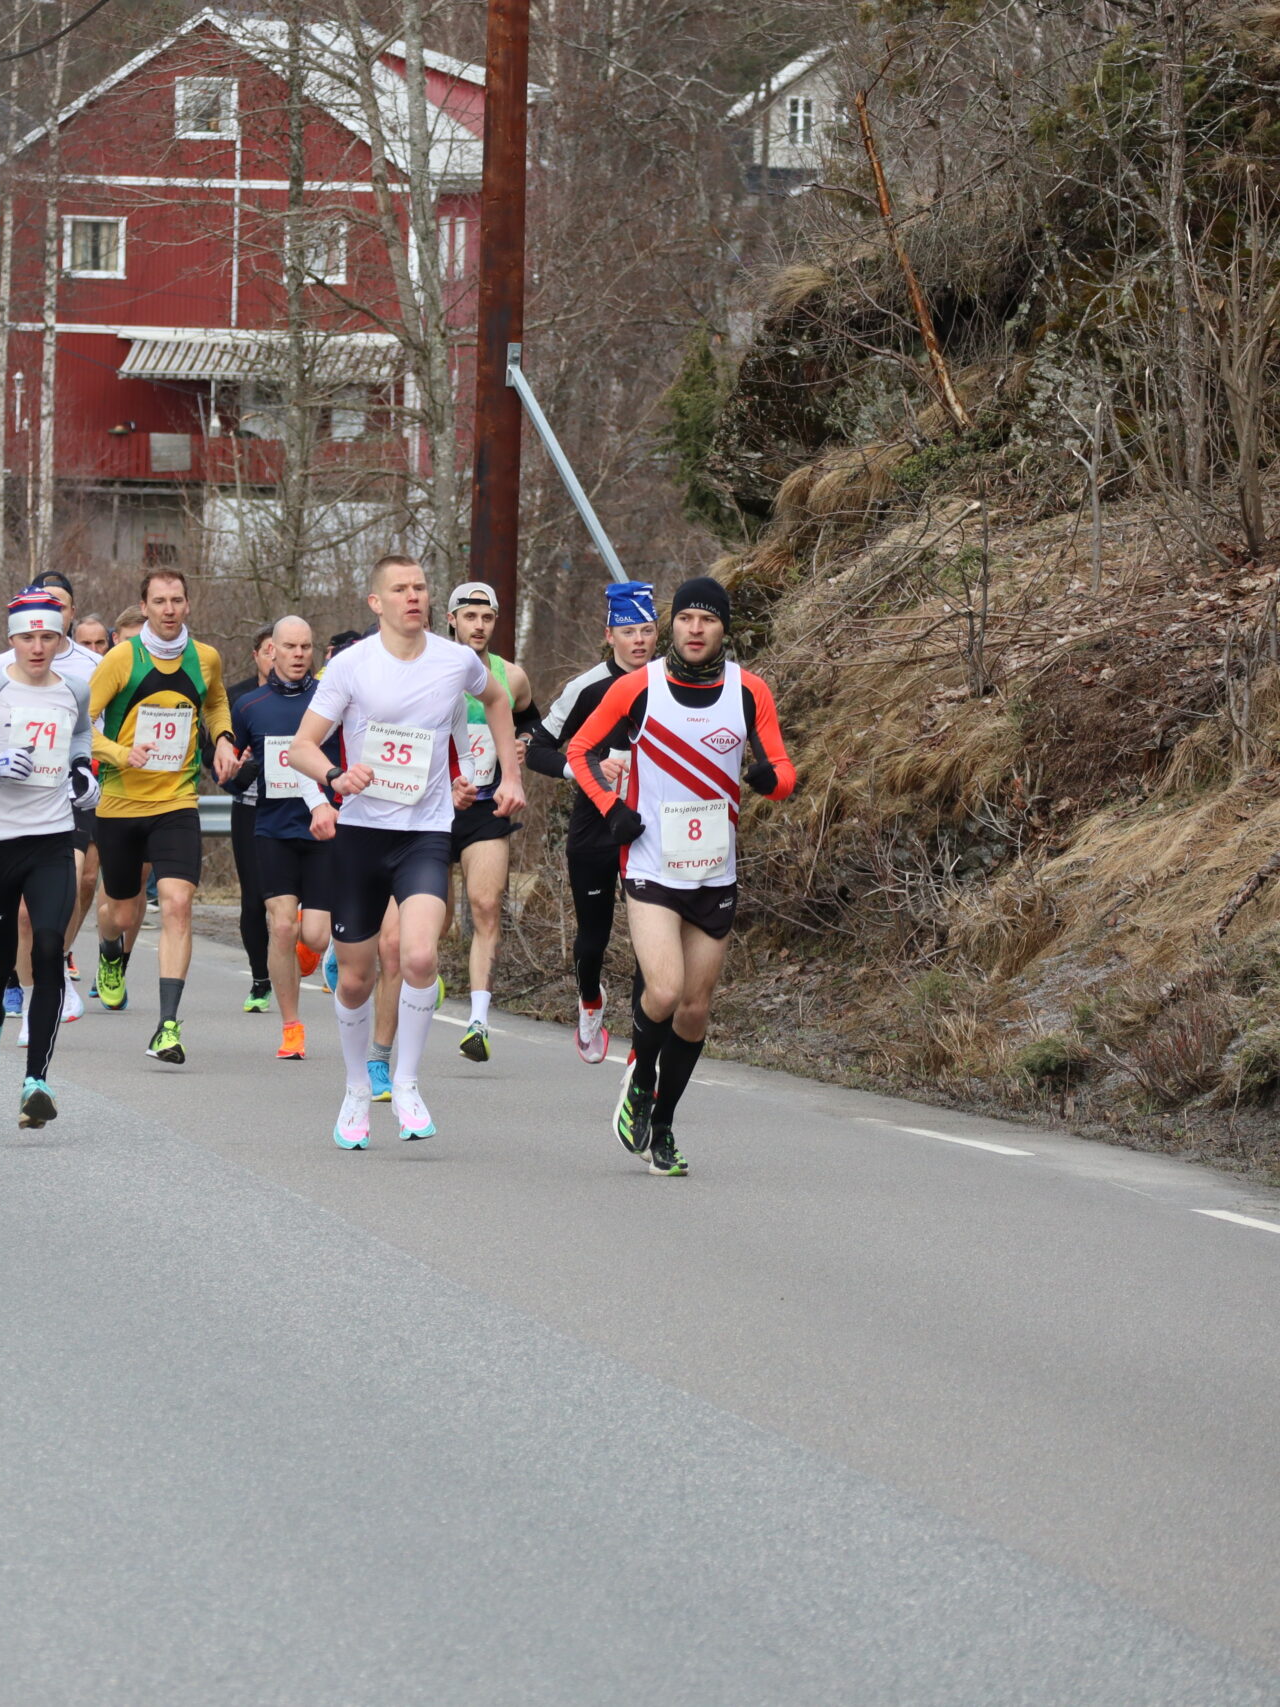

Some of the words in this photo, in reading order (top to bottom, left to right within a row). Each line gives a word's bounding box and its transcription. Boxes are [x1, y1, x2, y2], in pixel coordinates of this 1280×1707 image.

[26, 721, 57, 750] 79
[153, 722, 176, 740] 19
[370, 725, 414, 738] Baksjøløpet
[415, 732, 431, 741] 2023
[710, 737, 736, 745] VIDAR
[381, 741, 413, 765] 35
[33, 766, 58, 774] URA
[370, 777, 414, 793] ETURA
[664, 805, 708, 815] Baksjøløpet
[709, 802, 726, 812] 2023
[688, 818, 703, 841] 8
[667, 858, 718, 869] RETURA
